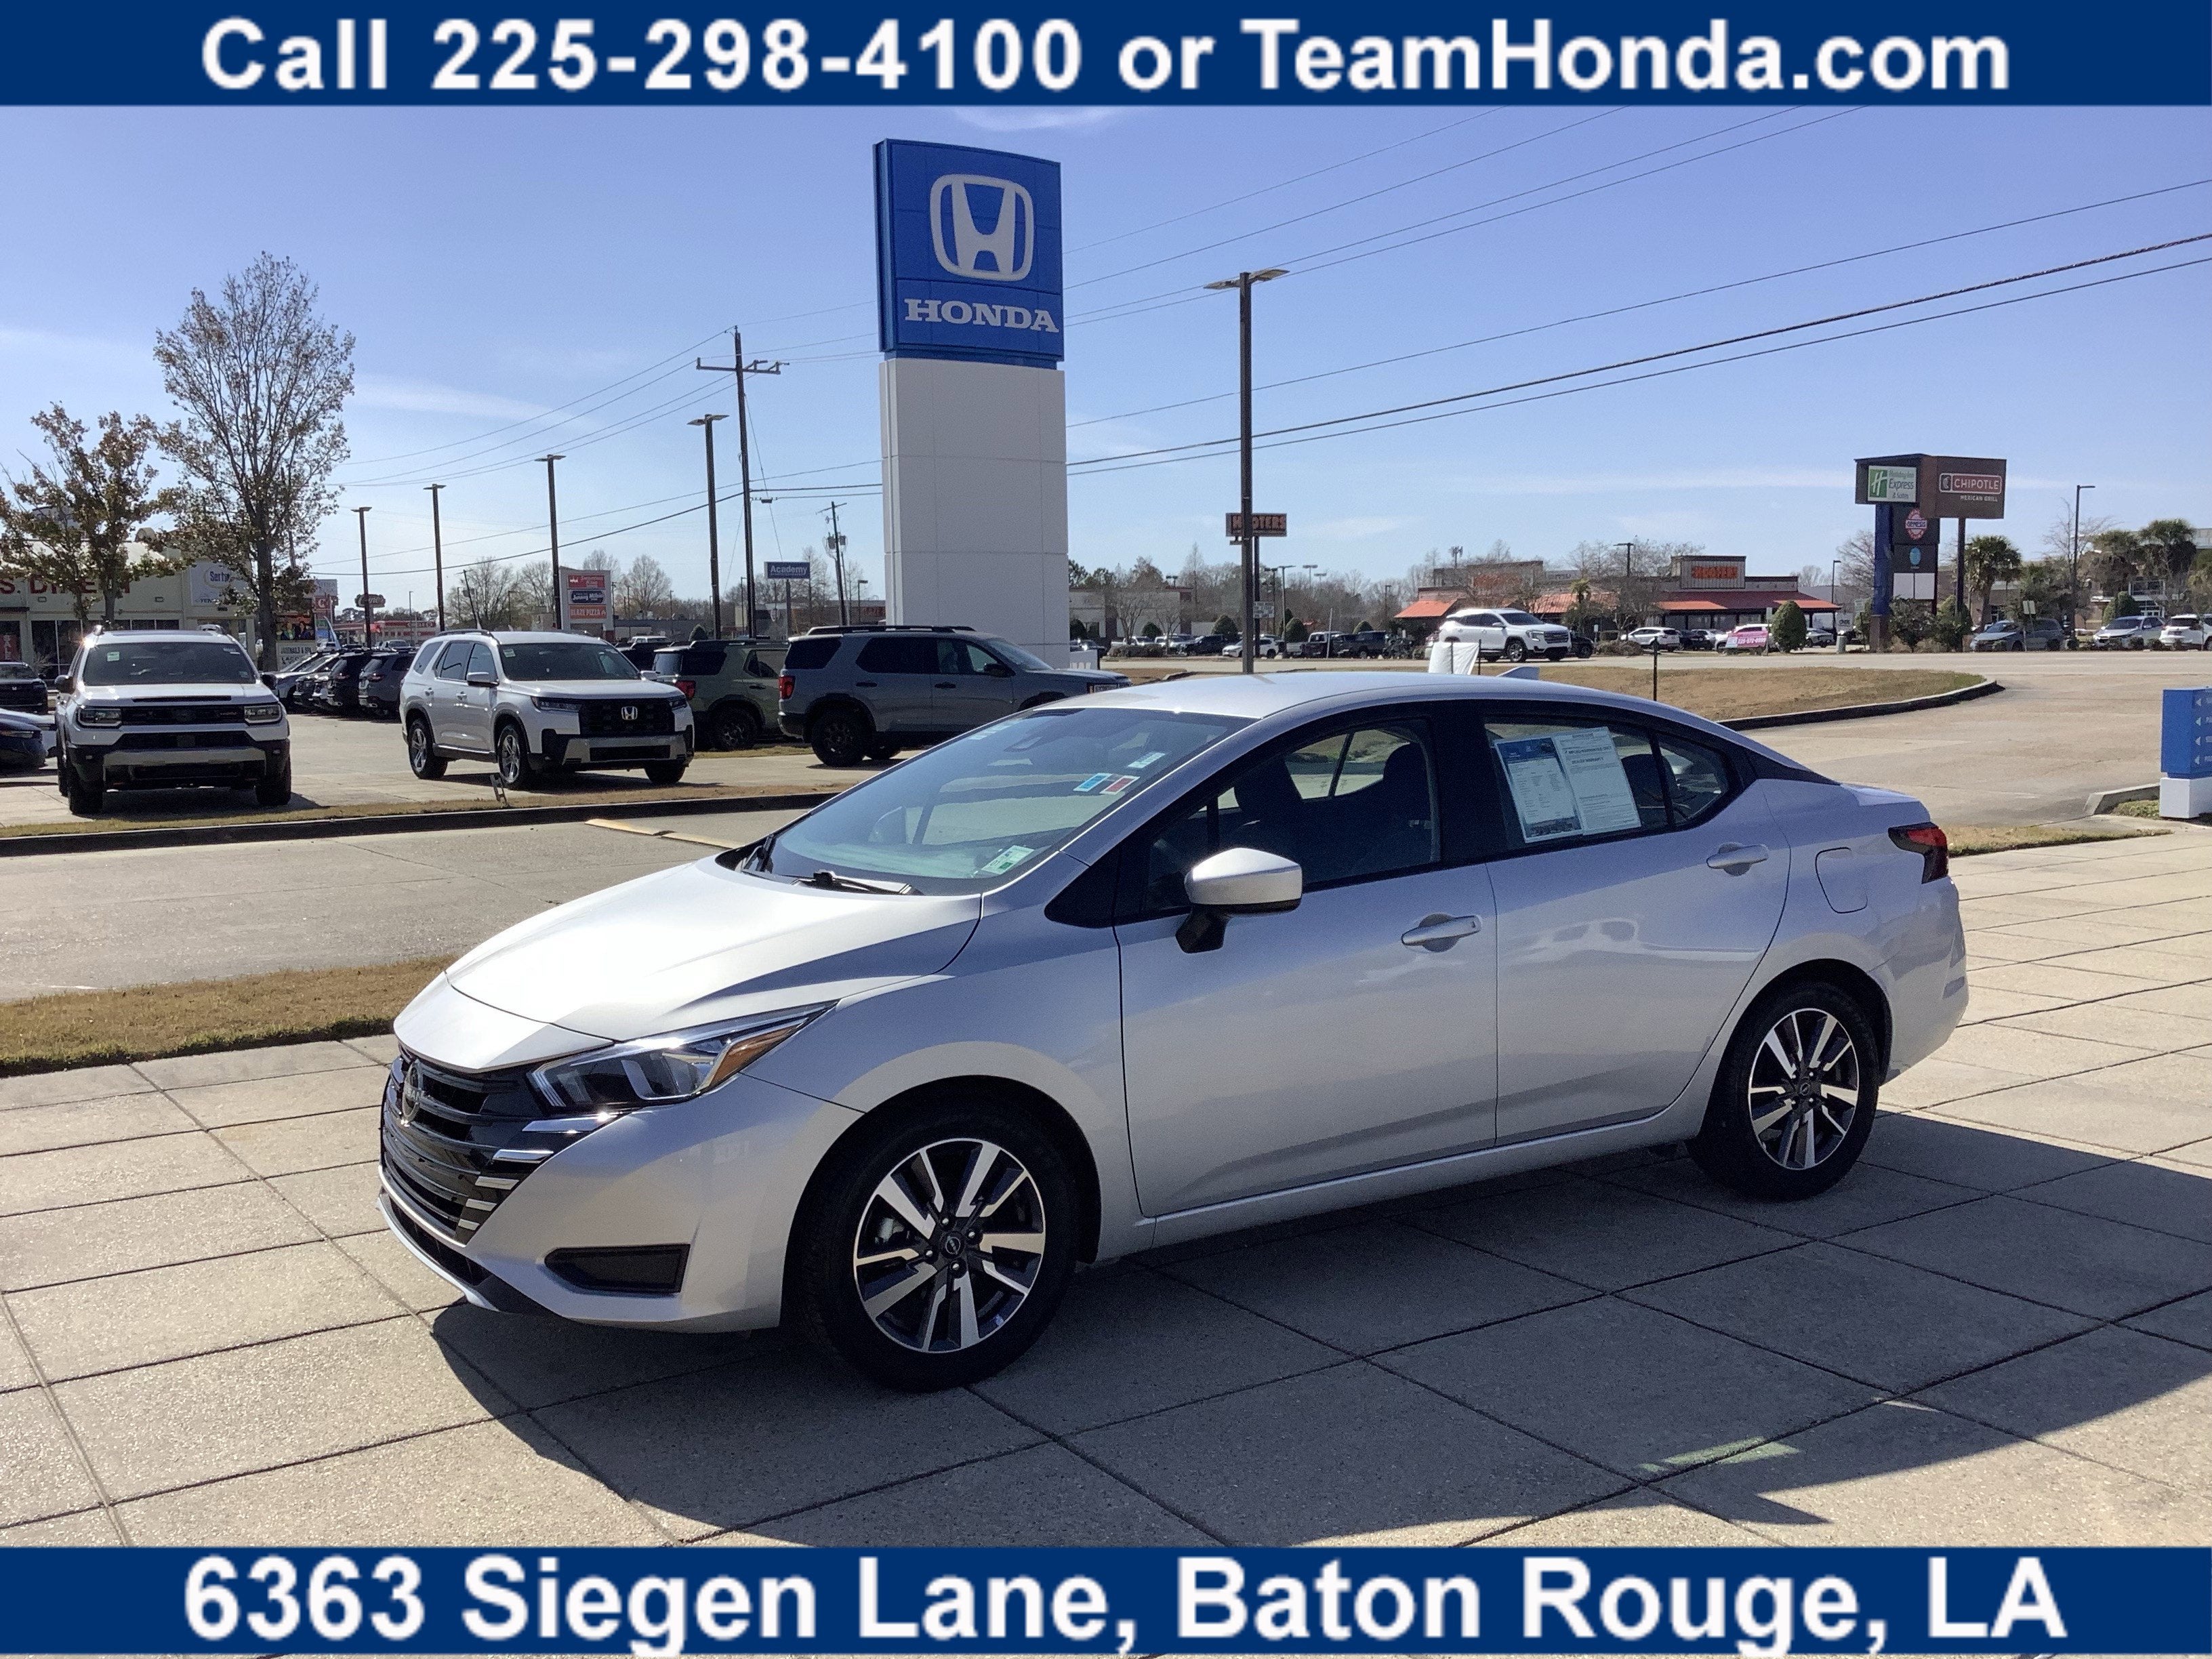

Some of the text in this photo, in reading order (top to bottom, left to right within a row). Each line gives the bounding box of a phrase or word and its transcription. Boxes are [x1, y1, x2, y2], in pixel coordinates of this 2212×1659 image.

[903, 298, 1059, 333] HONDA
[1889, 478, 1914, 490] Express
[1954, 478, 1999, 490] CHIPOTLE
[1233, 516, 1285, 529] HOTERS
[771, 565, 807, 575] Academy
